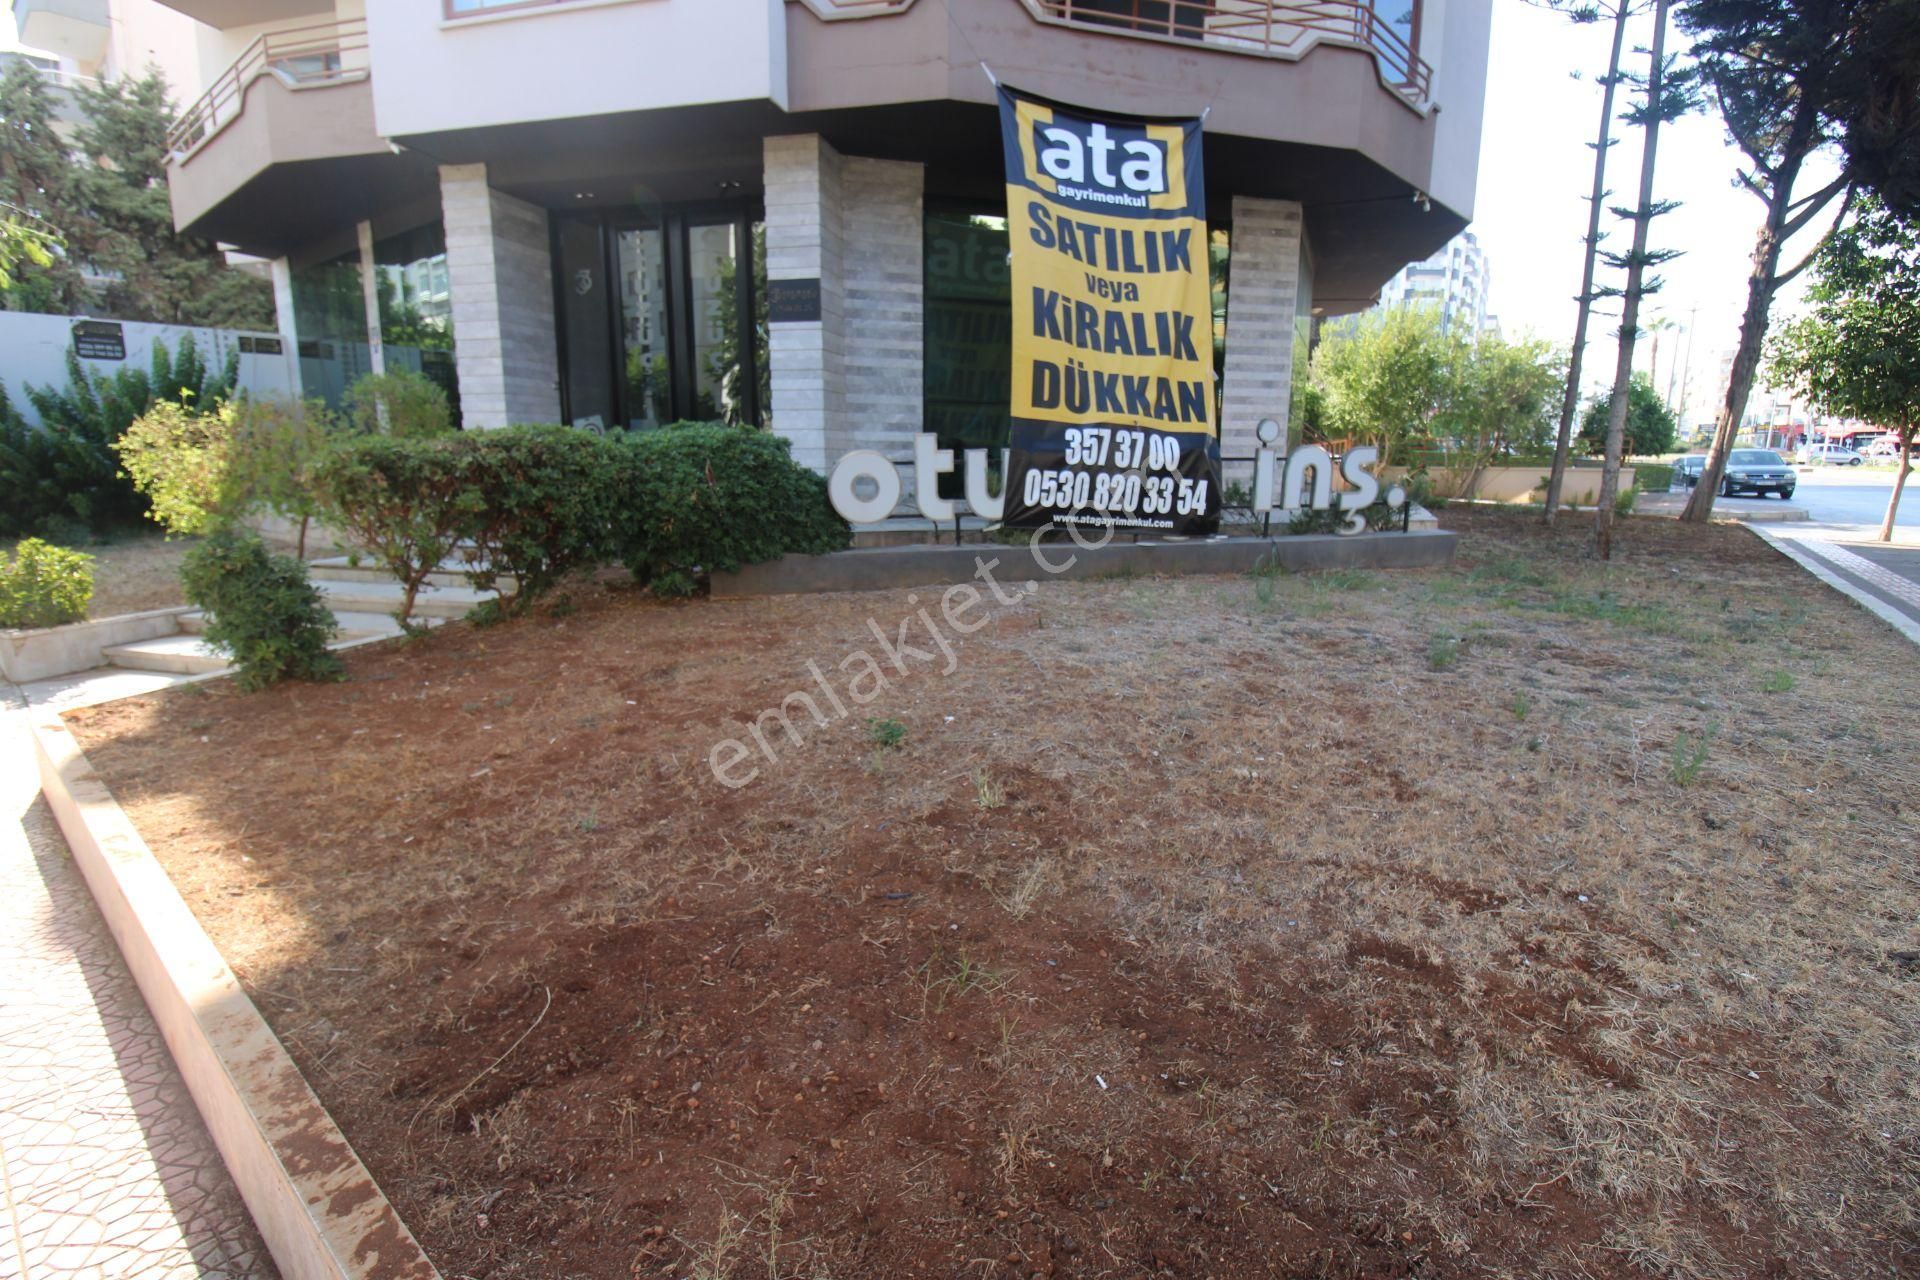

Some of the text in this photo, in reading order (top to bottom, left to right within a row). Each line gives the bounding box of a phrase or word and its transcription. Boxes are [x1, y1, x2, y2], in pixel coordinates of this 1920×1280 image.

[1041, 123, 1164, 192] ata
[1056, 183, 1147, 208] gayrimenkul
[1027, 200, 1193, 275] SATILIK
[1084, 271, 1139, 303] veya
[1031, 357, 1207, 424] DÜKKAN
[1064, 427, 1180, 472] 357 37 00
[828, 432, 1010, 524] otu
[1023, 468, 1208, 516] 0530 820 33 54
[1052, 513, 1174, 529] www.atagayrimenkul.com
